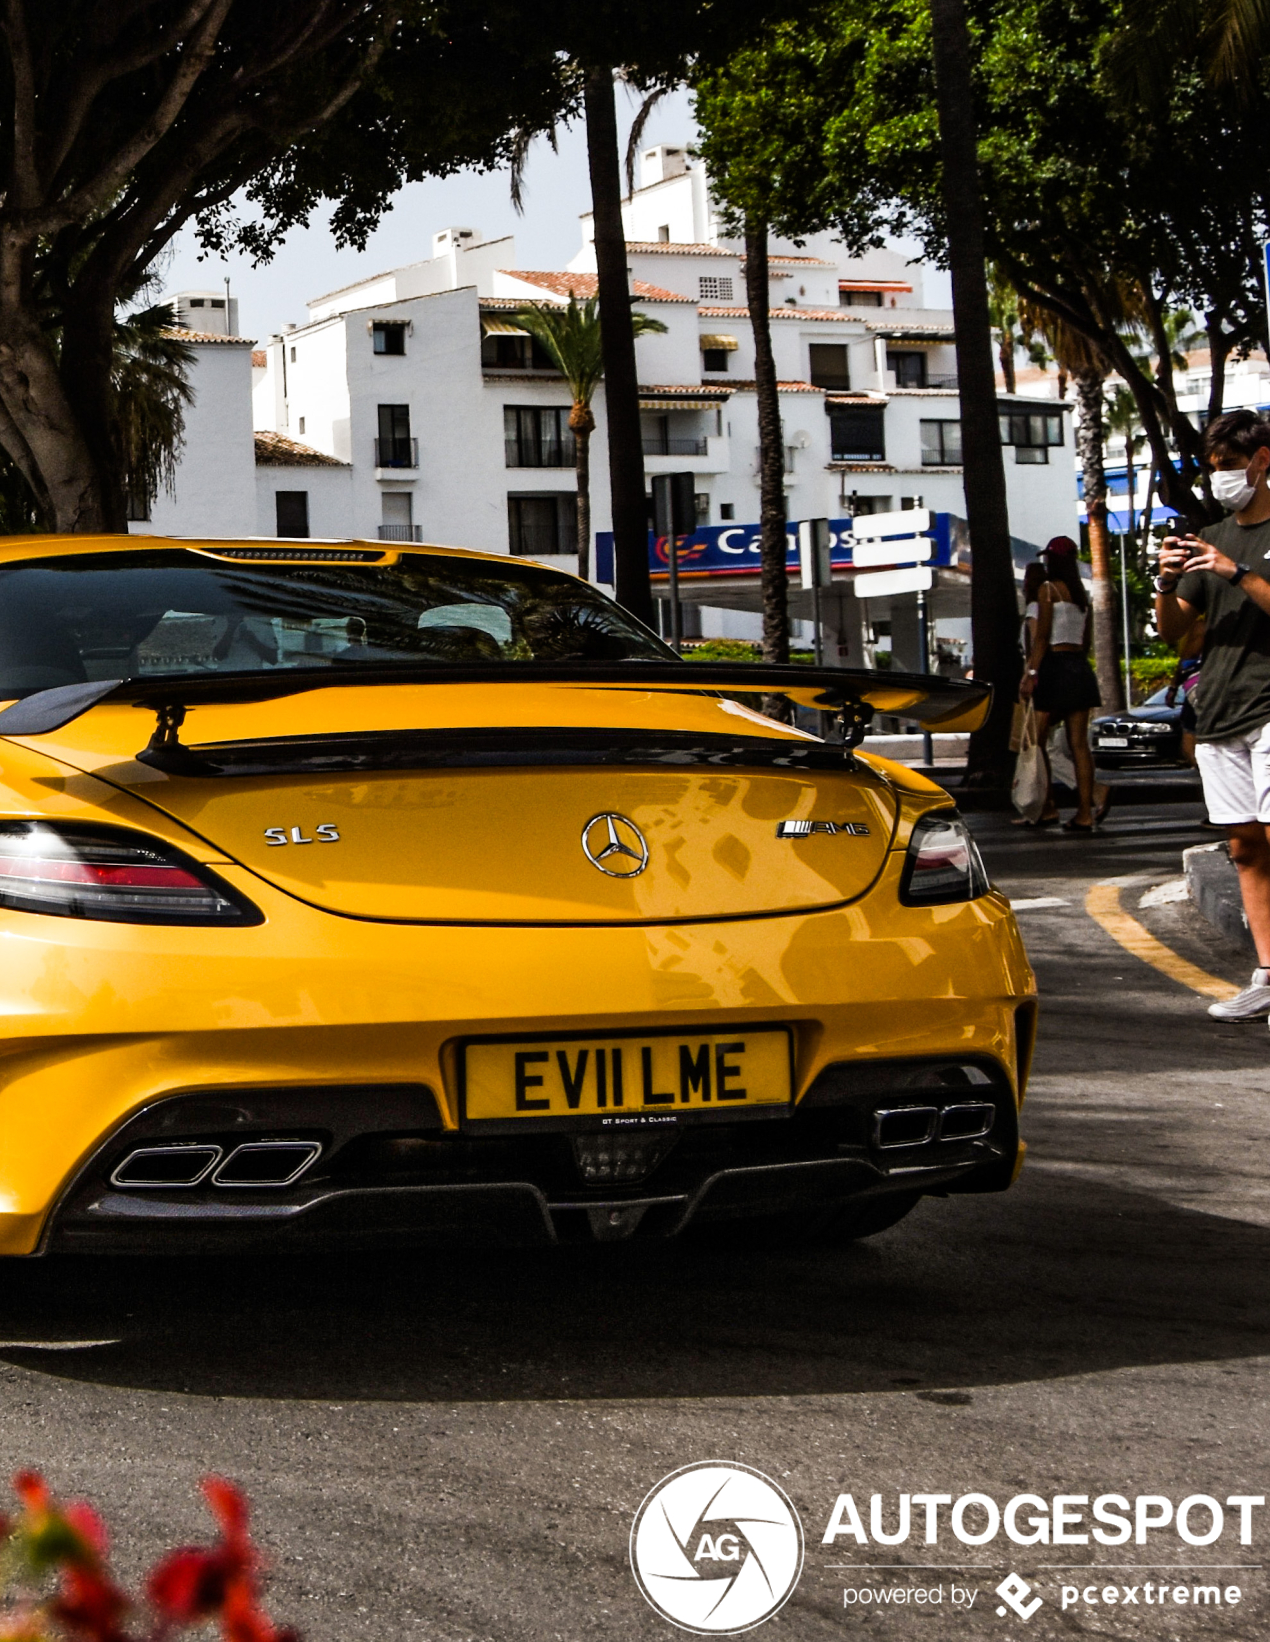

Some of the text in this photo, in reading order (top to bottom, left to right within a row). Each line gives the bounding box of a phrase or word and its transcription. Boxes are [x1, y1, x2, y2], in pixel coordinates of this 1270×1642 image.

[264, 824, 341, 846] SLS
[811, 821, 871, 836] AMG
[641, 1042, 748, 1106] LME
